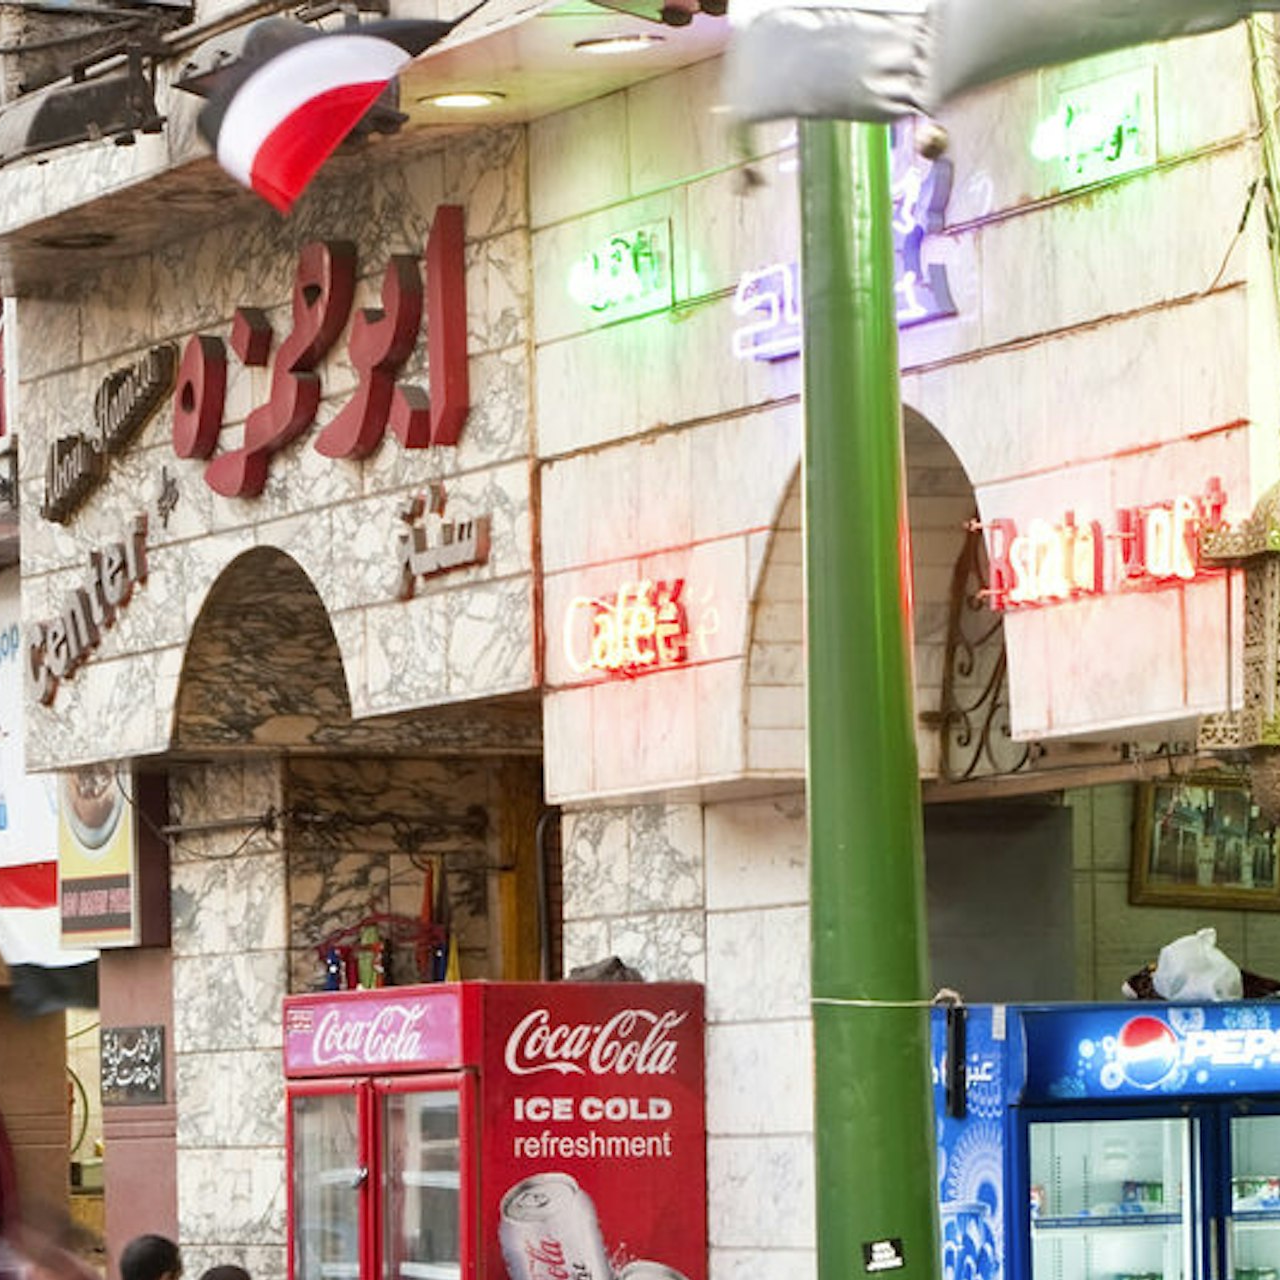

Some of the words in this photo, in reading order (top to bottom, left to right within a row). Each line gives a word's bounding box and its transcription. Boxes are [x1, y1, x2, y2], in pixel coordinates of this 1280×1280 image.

[504, 1007, 689, 1077] Coca-Cola
[514, 1097, 574, 1121] ICE
[581, 1097, 672, 1121] COLD
[514, 1130, 672, 1159] refreshment
